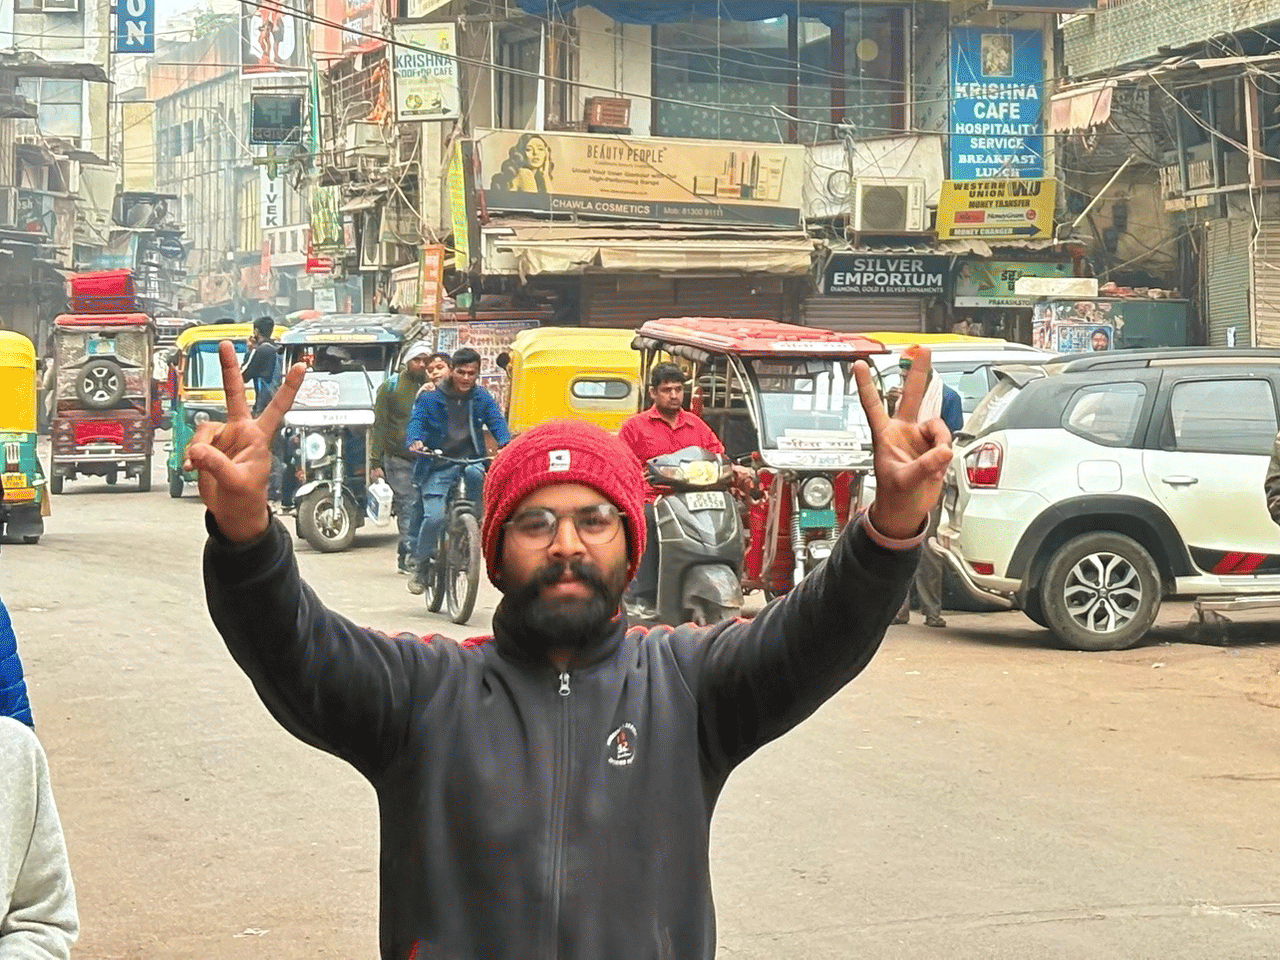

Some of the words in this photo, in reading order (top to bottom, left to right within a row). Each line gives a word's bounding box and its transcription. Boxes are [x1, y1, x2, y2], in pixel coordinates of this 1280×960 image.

[396, 54, 453, 68] KRISHNA
[434, 67, 453, 77] CAFE
[955, 82, 1039, 100] KRISHNA
[974, 102, 1021, 120] CAFE
[955, 123, 1039, 136] HOSPITALITY
[970, 137, 1025, 150] SERVICE
[587, 144, 625, 160] BEAUTY
[627, 148, 664, 163] PEOPLE
[958, 153, 1037, 165] BREAKFAST
[975, 167, 1020, 178] LUNCH
[953, 181, 1006, 191] WESTERN
[969, 189, 1005, 198] UNION
[552, 198, 593, 210] CHAWLA
[595, 201, 650, 215] COSMETICS
[853, 258, 924, 272] SILVER
[833, 272, 943, 287] EMPORIUM
[830, 286, 861, 294] DIAMOND,
